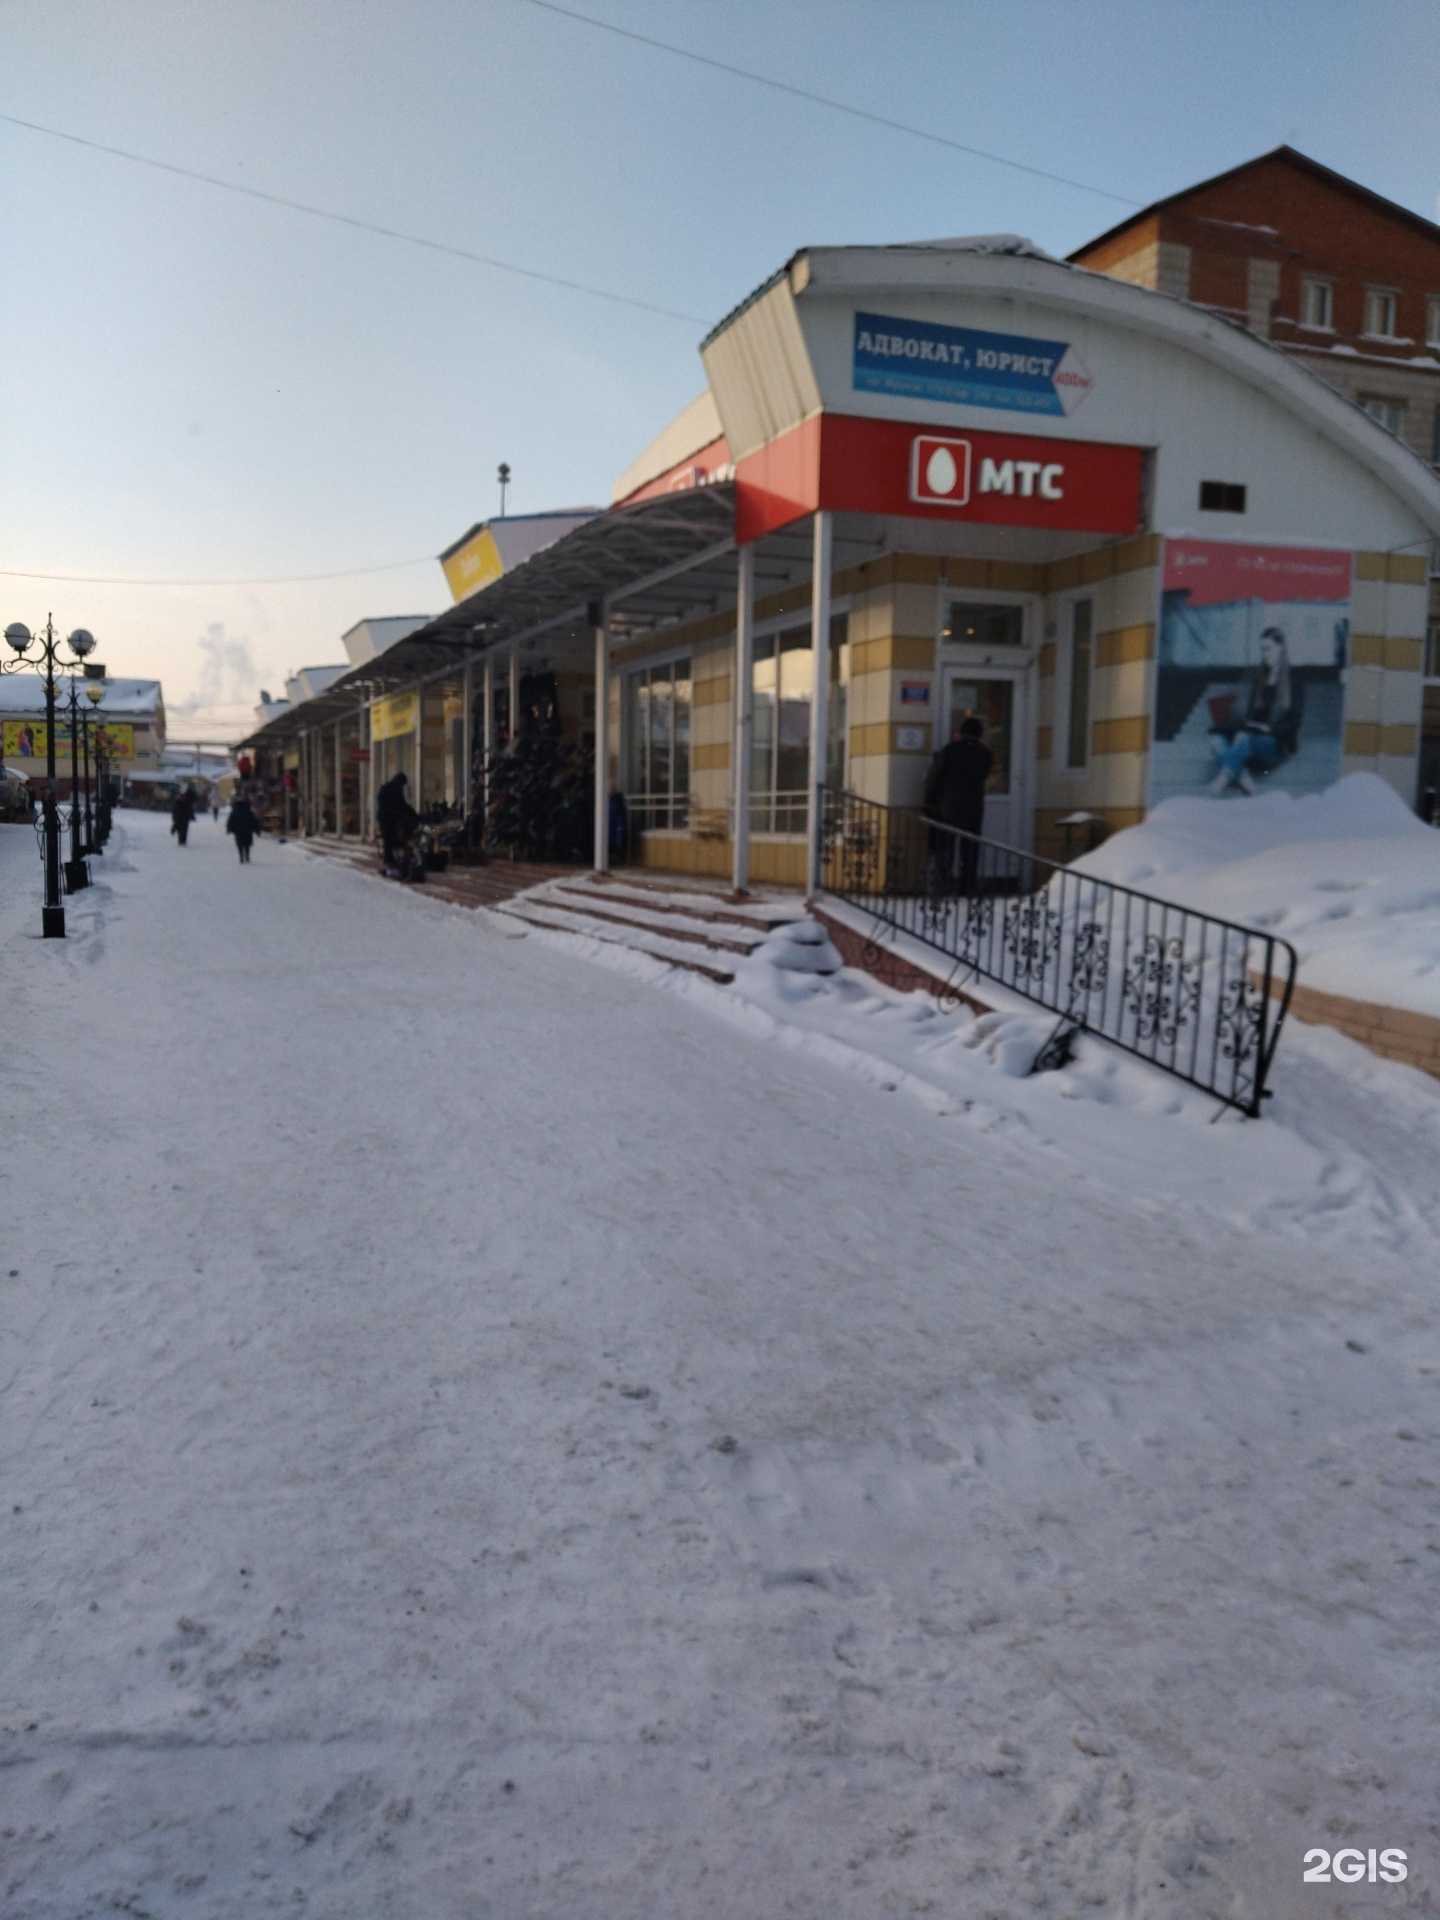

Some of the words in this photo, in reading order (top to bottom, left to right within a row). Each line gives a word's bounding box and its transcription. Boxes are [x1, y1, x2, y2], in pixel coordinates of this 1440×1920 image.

[857, 331, 971, 369] АДВОКАТ,
[975, 348, 1054, 377] ЮРИСТ
[979, 457, 1065, 500] МТС
